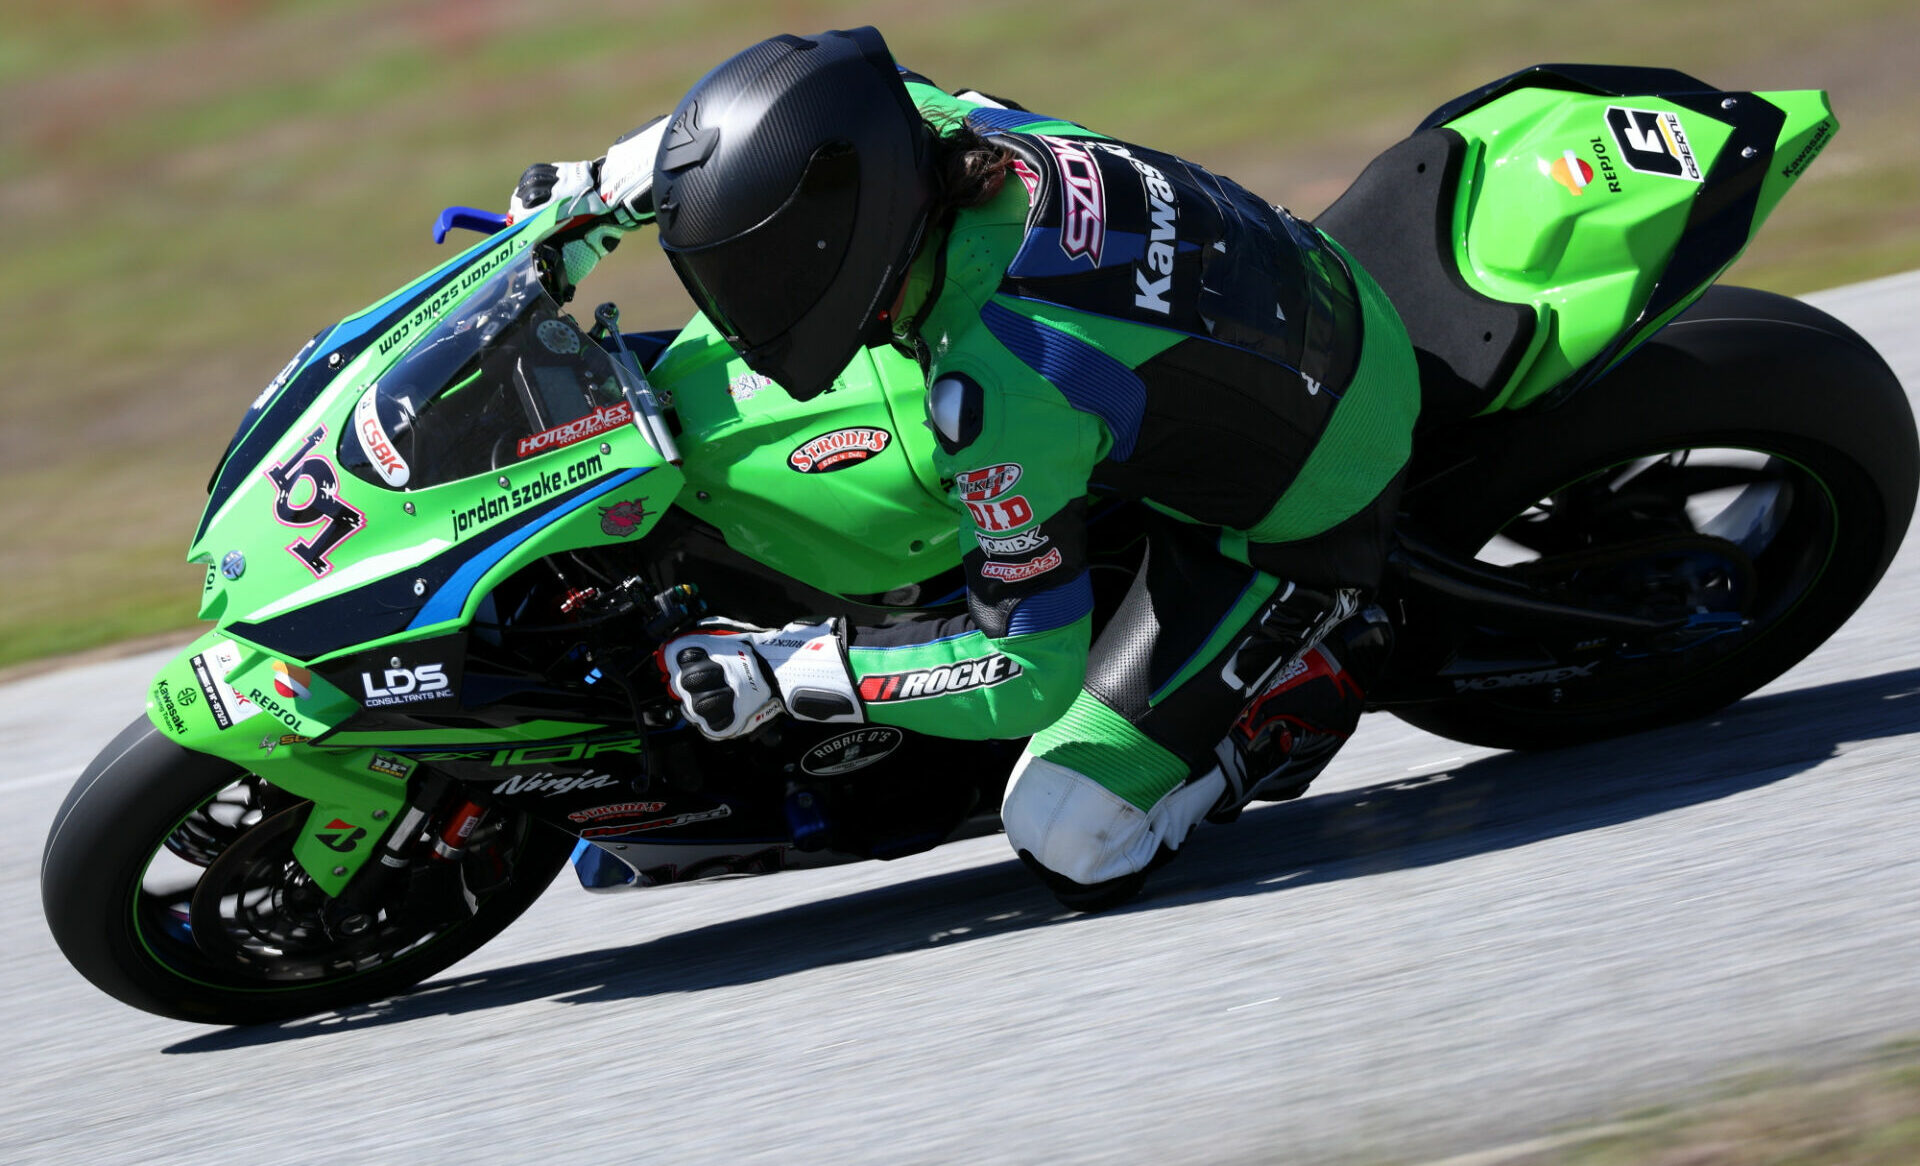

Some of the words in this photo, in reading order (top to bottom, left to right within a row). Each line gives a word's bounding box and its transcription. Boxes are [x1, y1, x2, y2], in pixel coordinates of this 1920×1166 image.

[1590, 136, 1622, 194] REPSOL
[363, 418, 405, 476] CSBK
[451, 495, 510, 541] jordan
[511, 453, 604, 509] szoke.com
[977, 527, 1041, 554] VORTEX
[361, 664, 449, 697] LDS
[365, 692, 436, 708] CONSULTANTS
[158, 679, 187, 735] Kawasaki
[250, 688, 303, 733] REPSOL
[493, 769, 620, 798] Ninja
